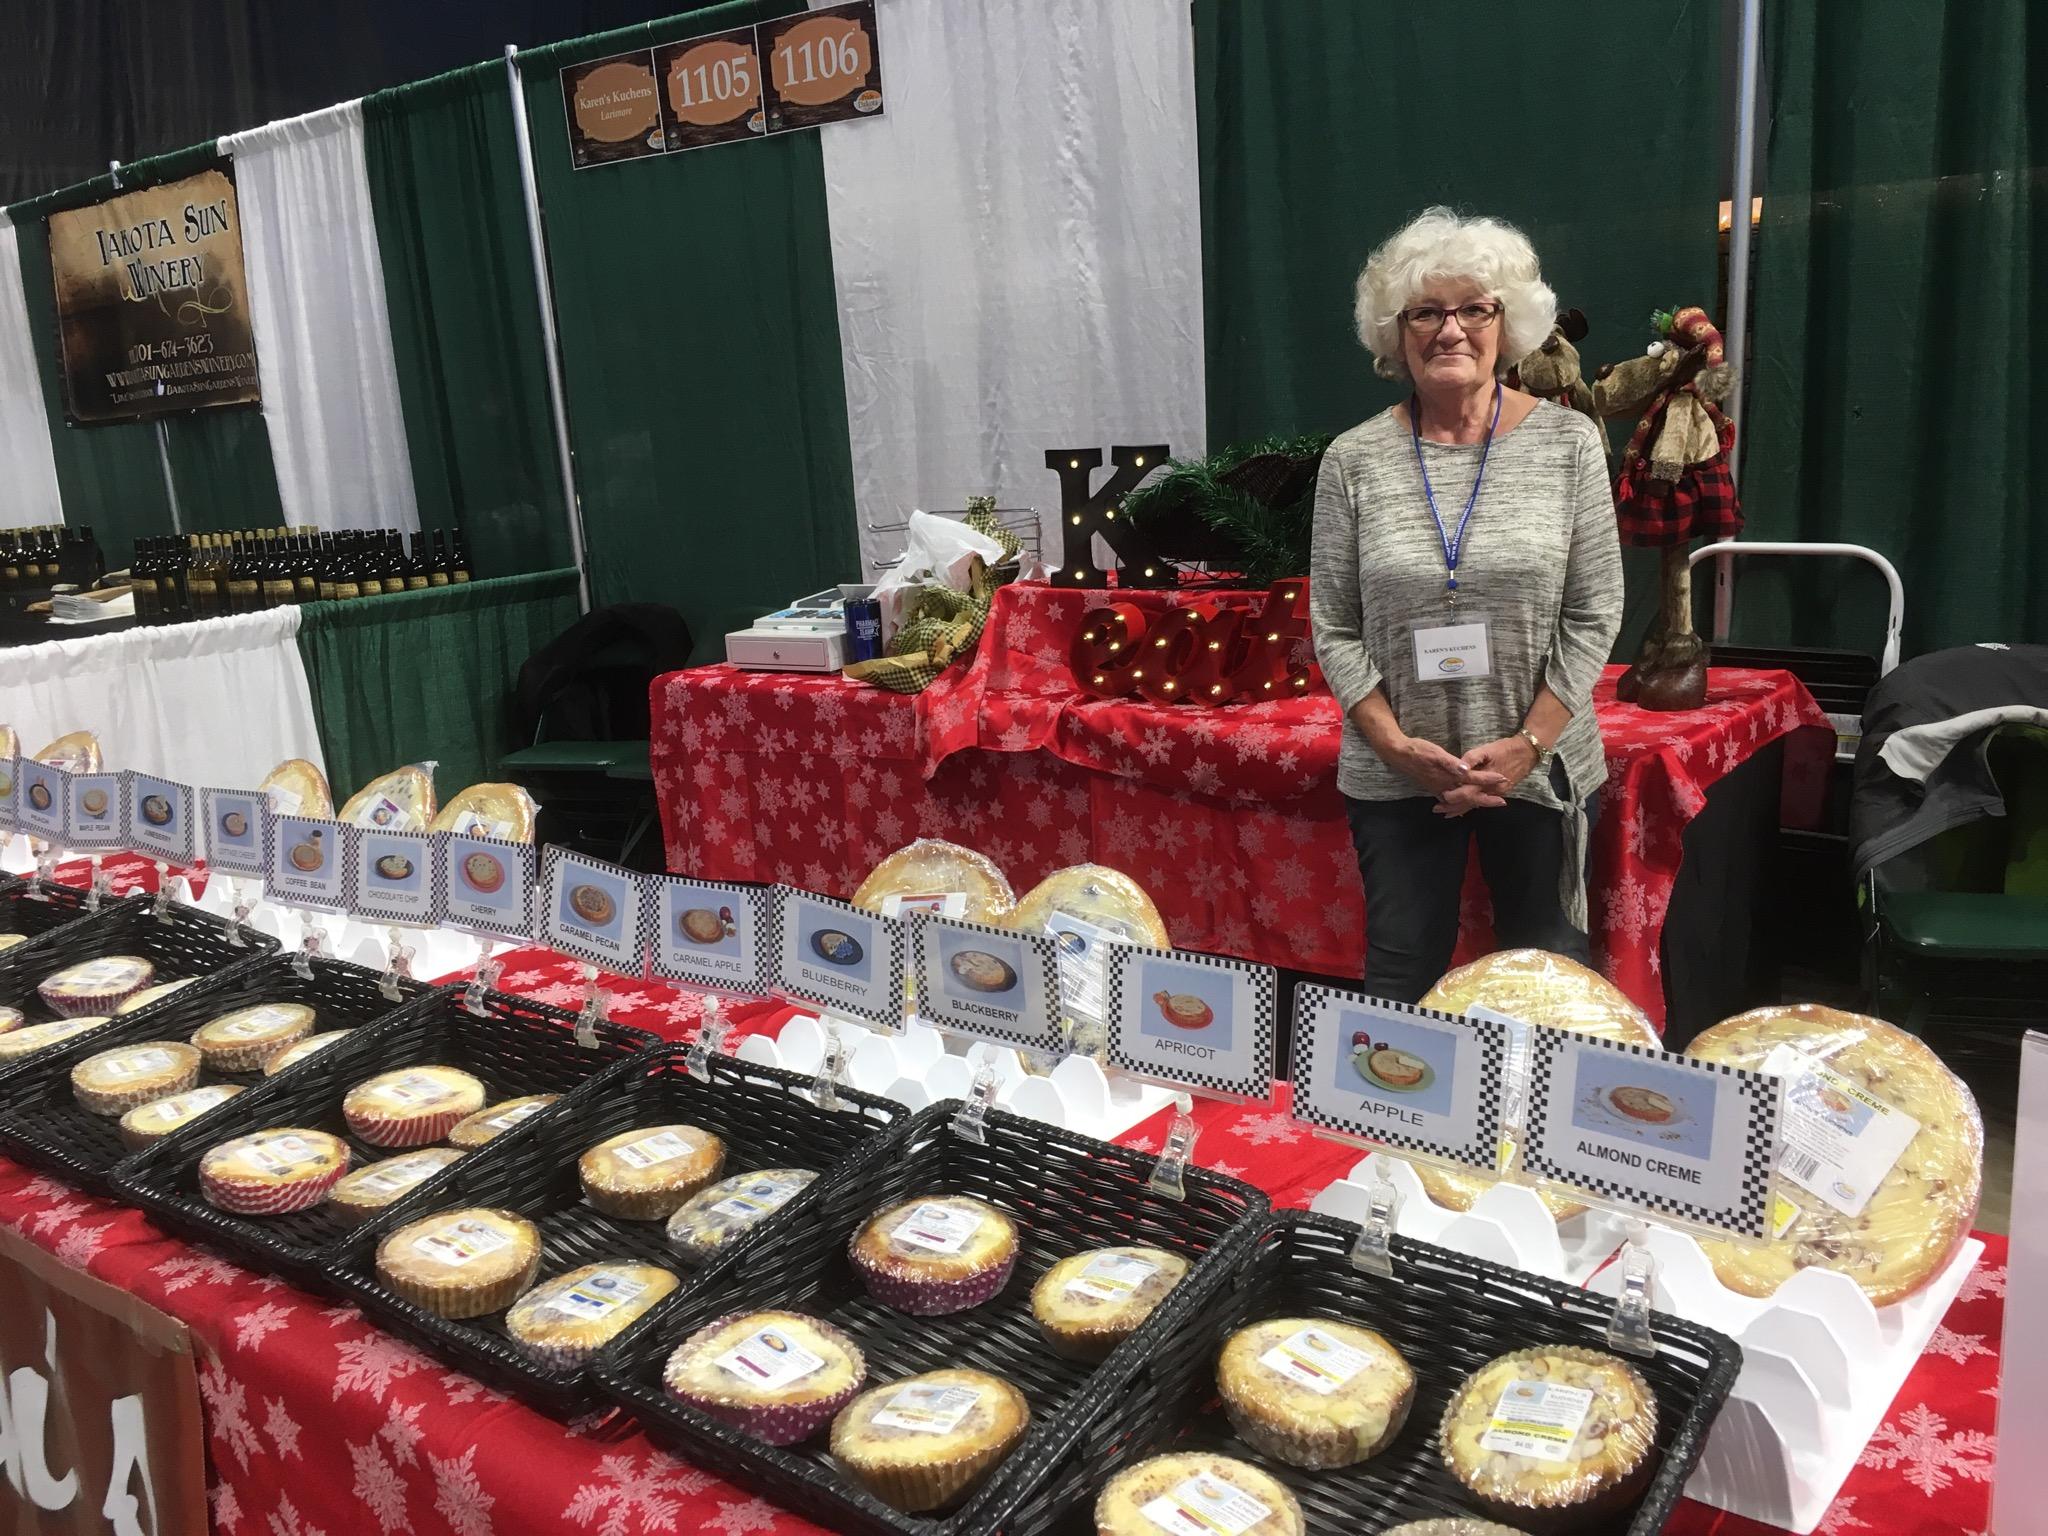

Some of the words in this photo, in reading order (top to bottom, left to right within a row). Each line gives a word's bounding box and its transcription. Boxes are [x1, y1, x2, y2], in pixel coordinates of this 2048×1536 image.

[780, 31, 859, 87] 1106
[676, 55, 750, 107] 1105
[580, 94, 611, 110] Karen's
[612, 87, 652, 102] Kuchens
[184, 199, 229, 243] SUN
[126, 256, 205, 299] WINERY
[1045, 445, 1178, 589] K
[285, 877, 308, 888] COFFEE
[310, 880, 326, 891] BEAN
[368, 890, 403, 903] CHOCOLATE
[404, 894, 420, 904] CHIP
[470, 903, 497, 917] CHERRY
[559, 923, 594, 944] CARAMEL
[595, 936, 620, 953] PECAN
[672, 952, 712, 969] CARAMEL
[714, 958, 742, 973] APPLE
[801, 968, 868, 997] BLUEBERRY
[952, 999, 1019, 1024] BLACKBERRY
[1154, 1038, 1216, 1061] APRICOT
[1358, 1100, 1425, 1128] APPLE
[1847, 1086, 1890, 1116] CREME
[1576, 1140, 1642, 1170] ALMOND
[1645, 1157, 1702, 1185] CREME
